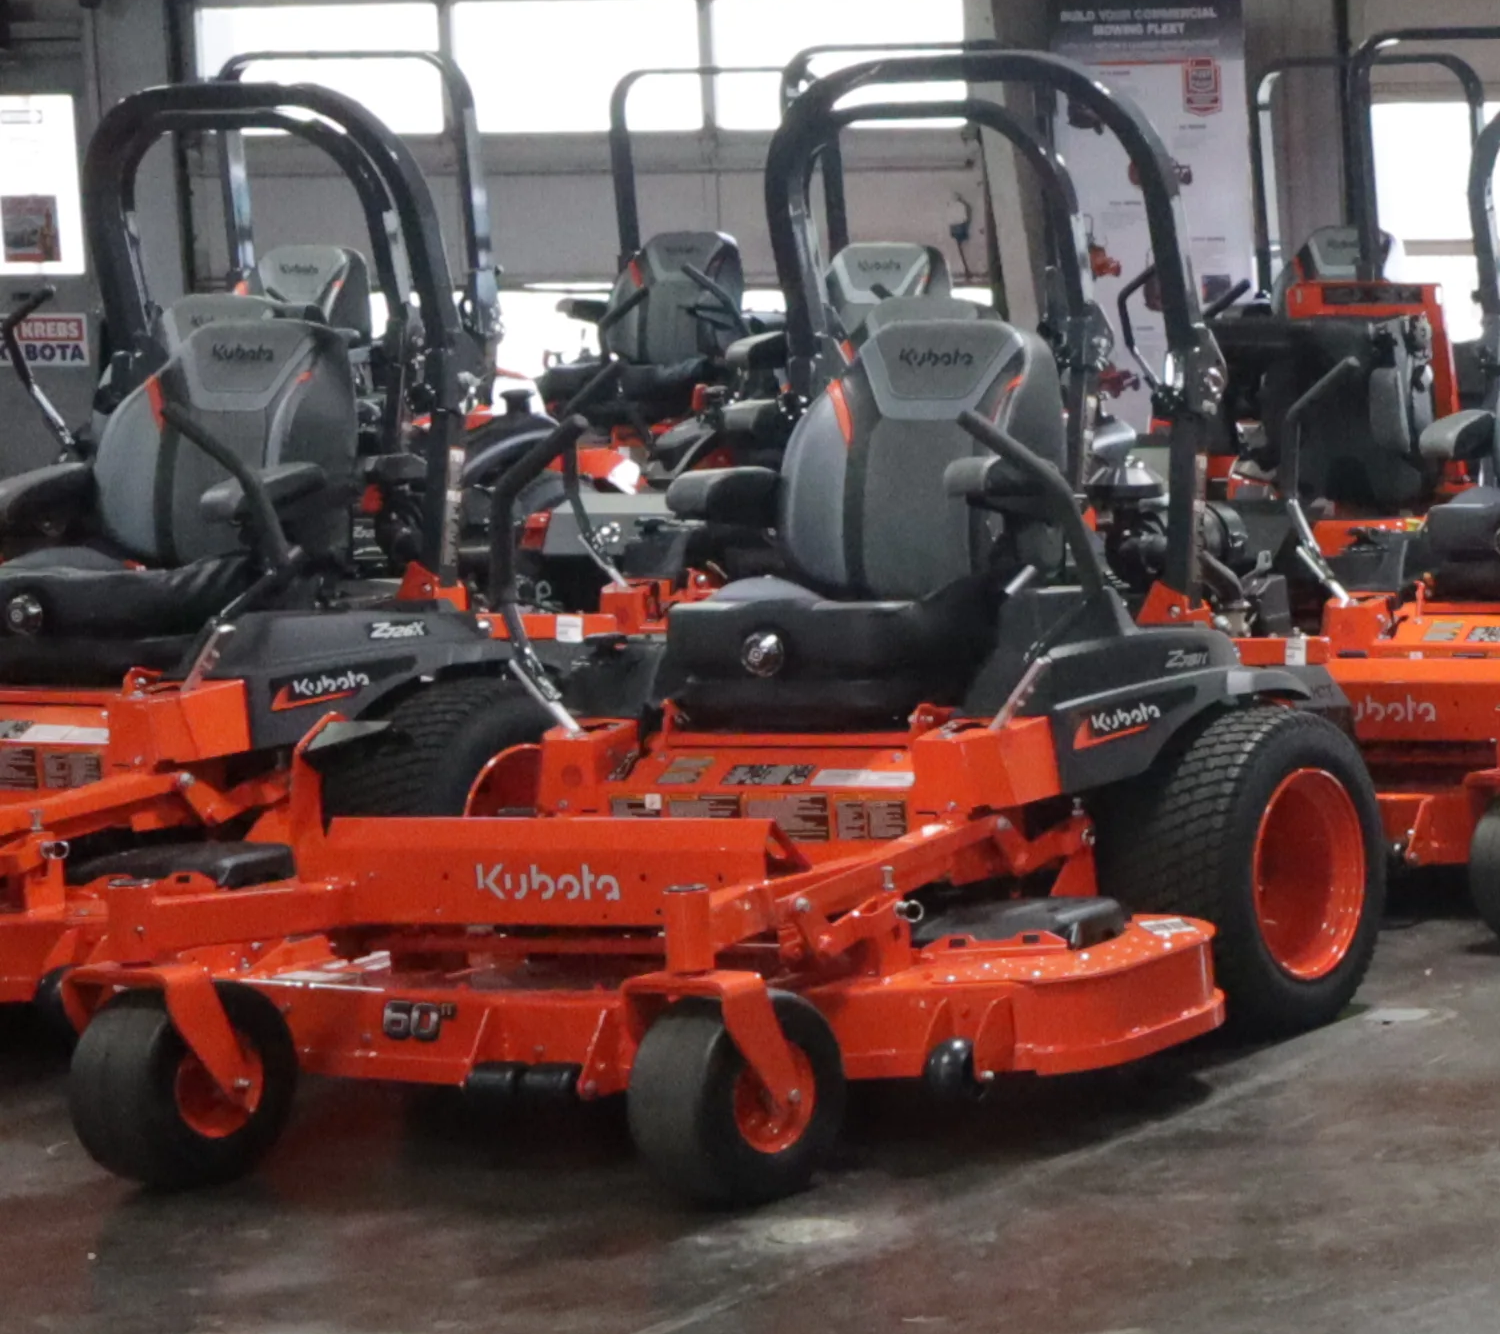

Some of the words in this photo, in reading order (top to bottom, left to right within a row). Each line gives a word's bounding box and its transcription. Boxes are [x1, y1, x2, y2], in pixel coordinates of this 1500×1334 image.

[21, 321, 79, 338] KREBS
[212, 343, 274, 362] Kubota
[899, 347, 974, 368] Kubota
[292, 670, 370, 696] Kubota
[1090, 702, 1161, 732] Kubota
[1354, 693, 1437, 722] ubota
[475, 862, 621, 901] Kubota
